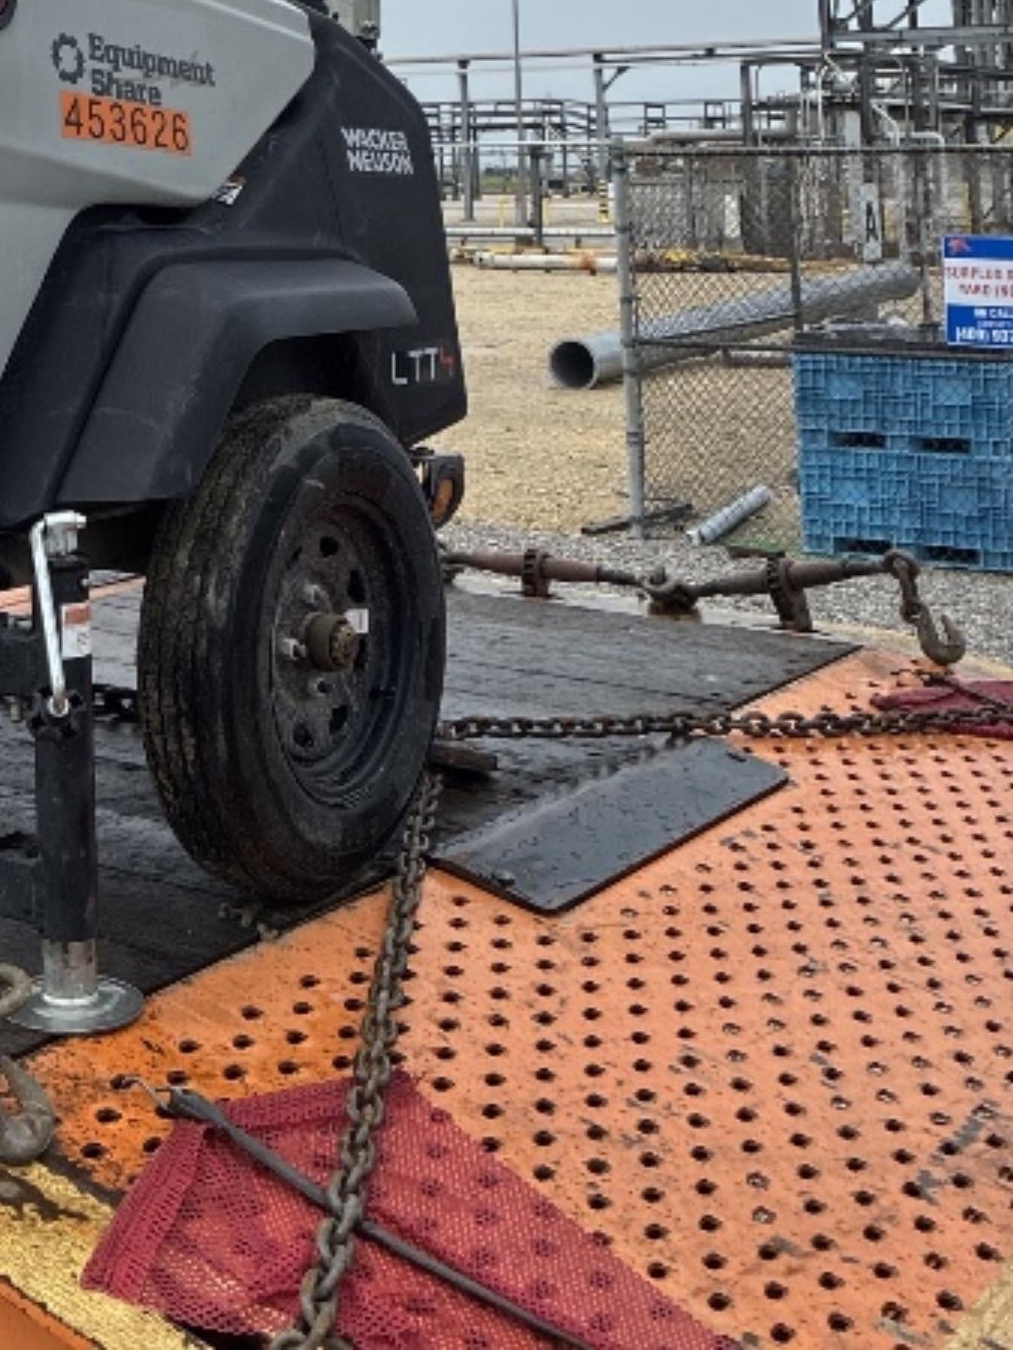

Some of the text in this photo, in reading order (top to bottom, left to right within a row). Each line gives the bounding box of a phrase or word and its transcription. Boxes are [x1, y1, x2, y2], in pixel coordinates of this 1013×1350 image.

[87, 32, 216, 88] Equipment
[91, 68, 163, 106] Share
[64, 97, 190, 151] 453626
[340, 126, 407, 150] WACKER
[347, 149, 414, 175] NEUSON
[391, 346, 454, 385] LTT4
